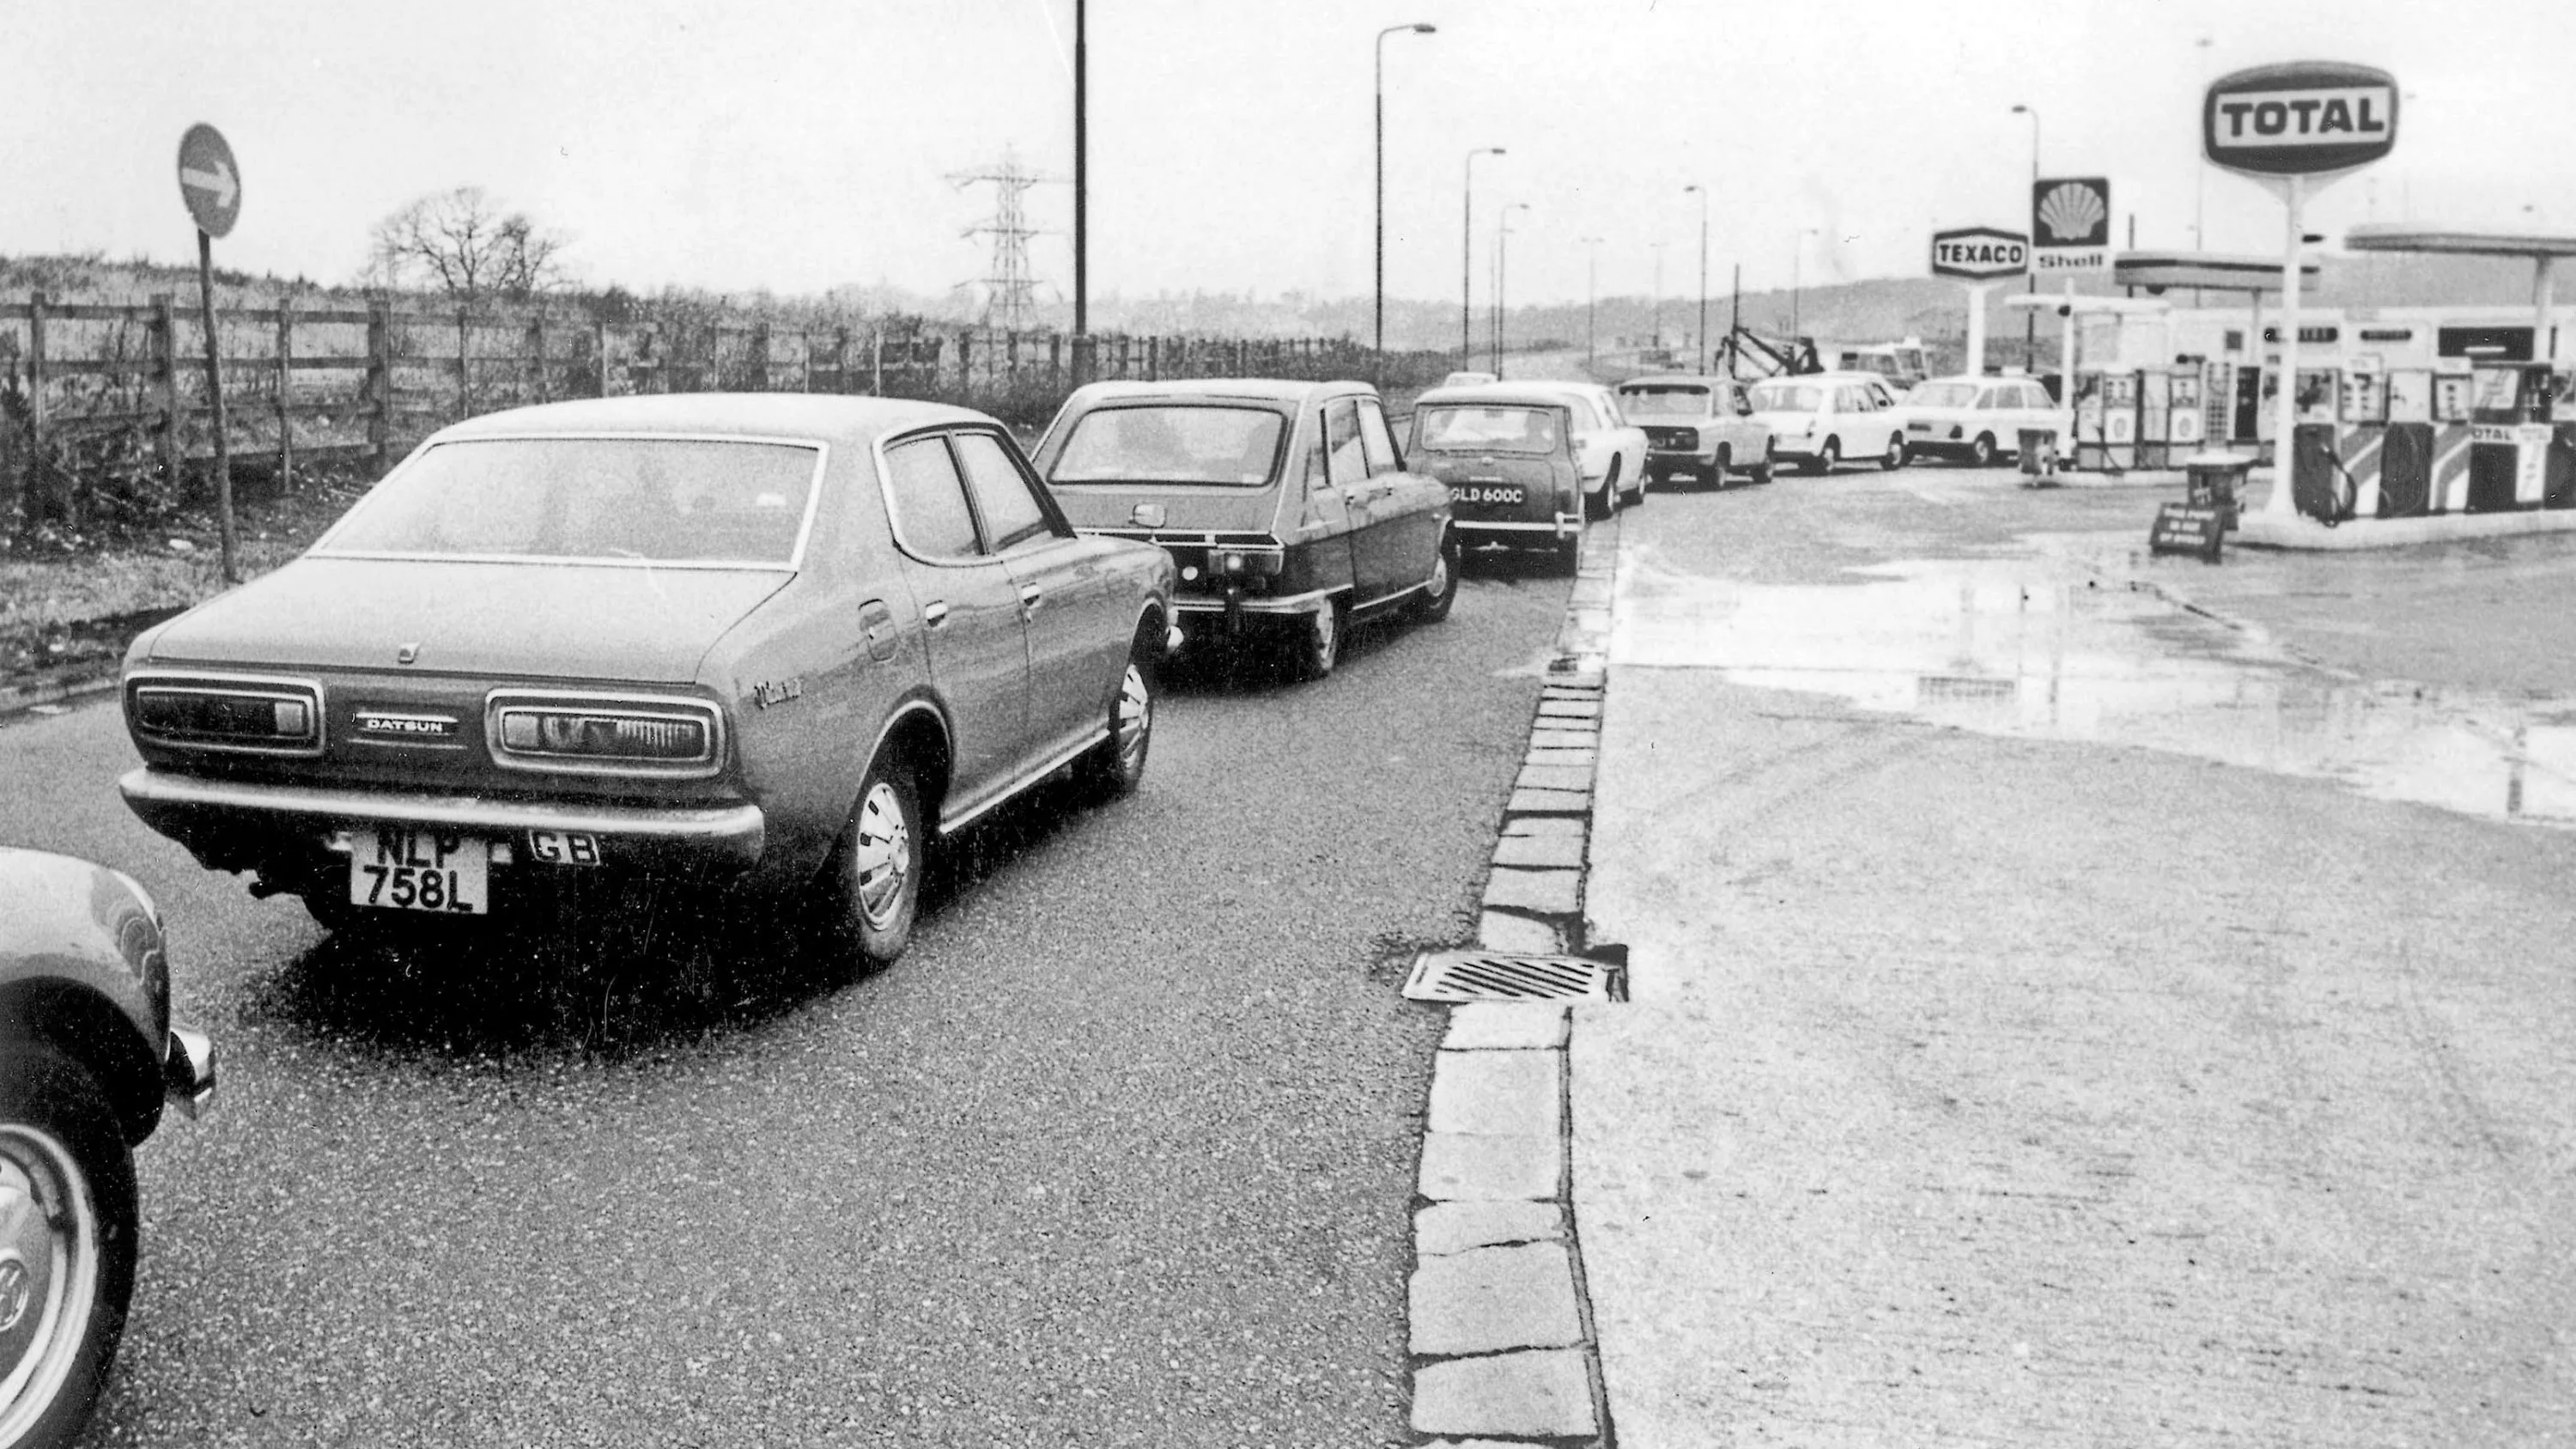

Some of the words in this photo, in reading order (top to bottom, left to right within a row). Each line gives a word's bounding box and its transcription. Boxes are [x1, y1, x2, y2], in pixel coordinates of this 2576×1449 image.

[2221, 97, 2385, 137] TOTAL
[1938, 243, 2024, 264] TEXACO
[2472, 428, 2512, 441] OTAL
[1450, 486, 1481, 502] GLD
[1482, 487, 1522, 504] 600C
[366, 719, 444, 733] DATSUN
[377, 826, 461, 869] NLP
[532, 831, 598, 865] GB
[362, 864, 474, 914] 758L
